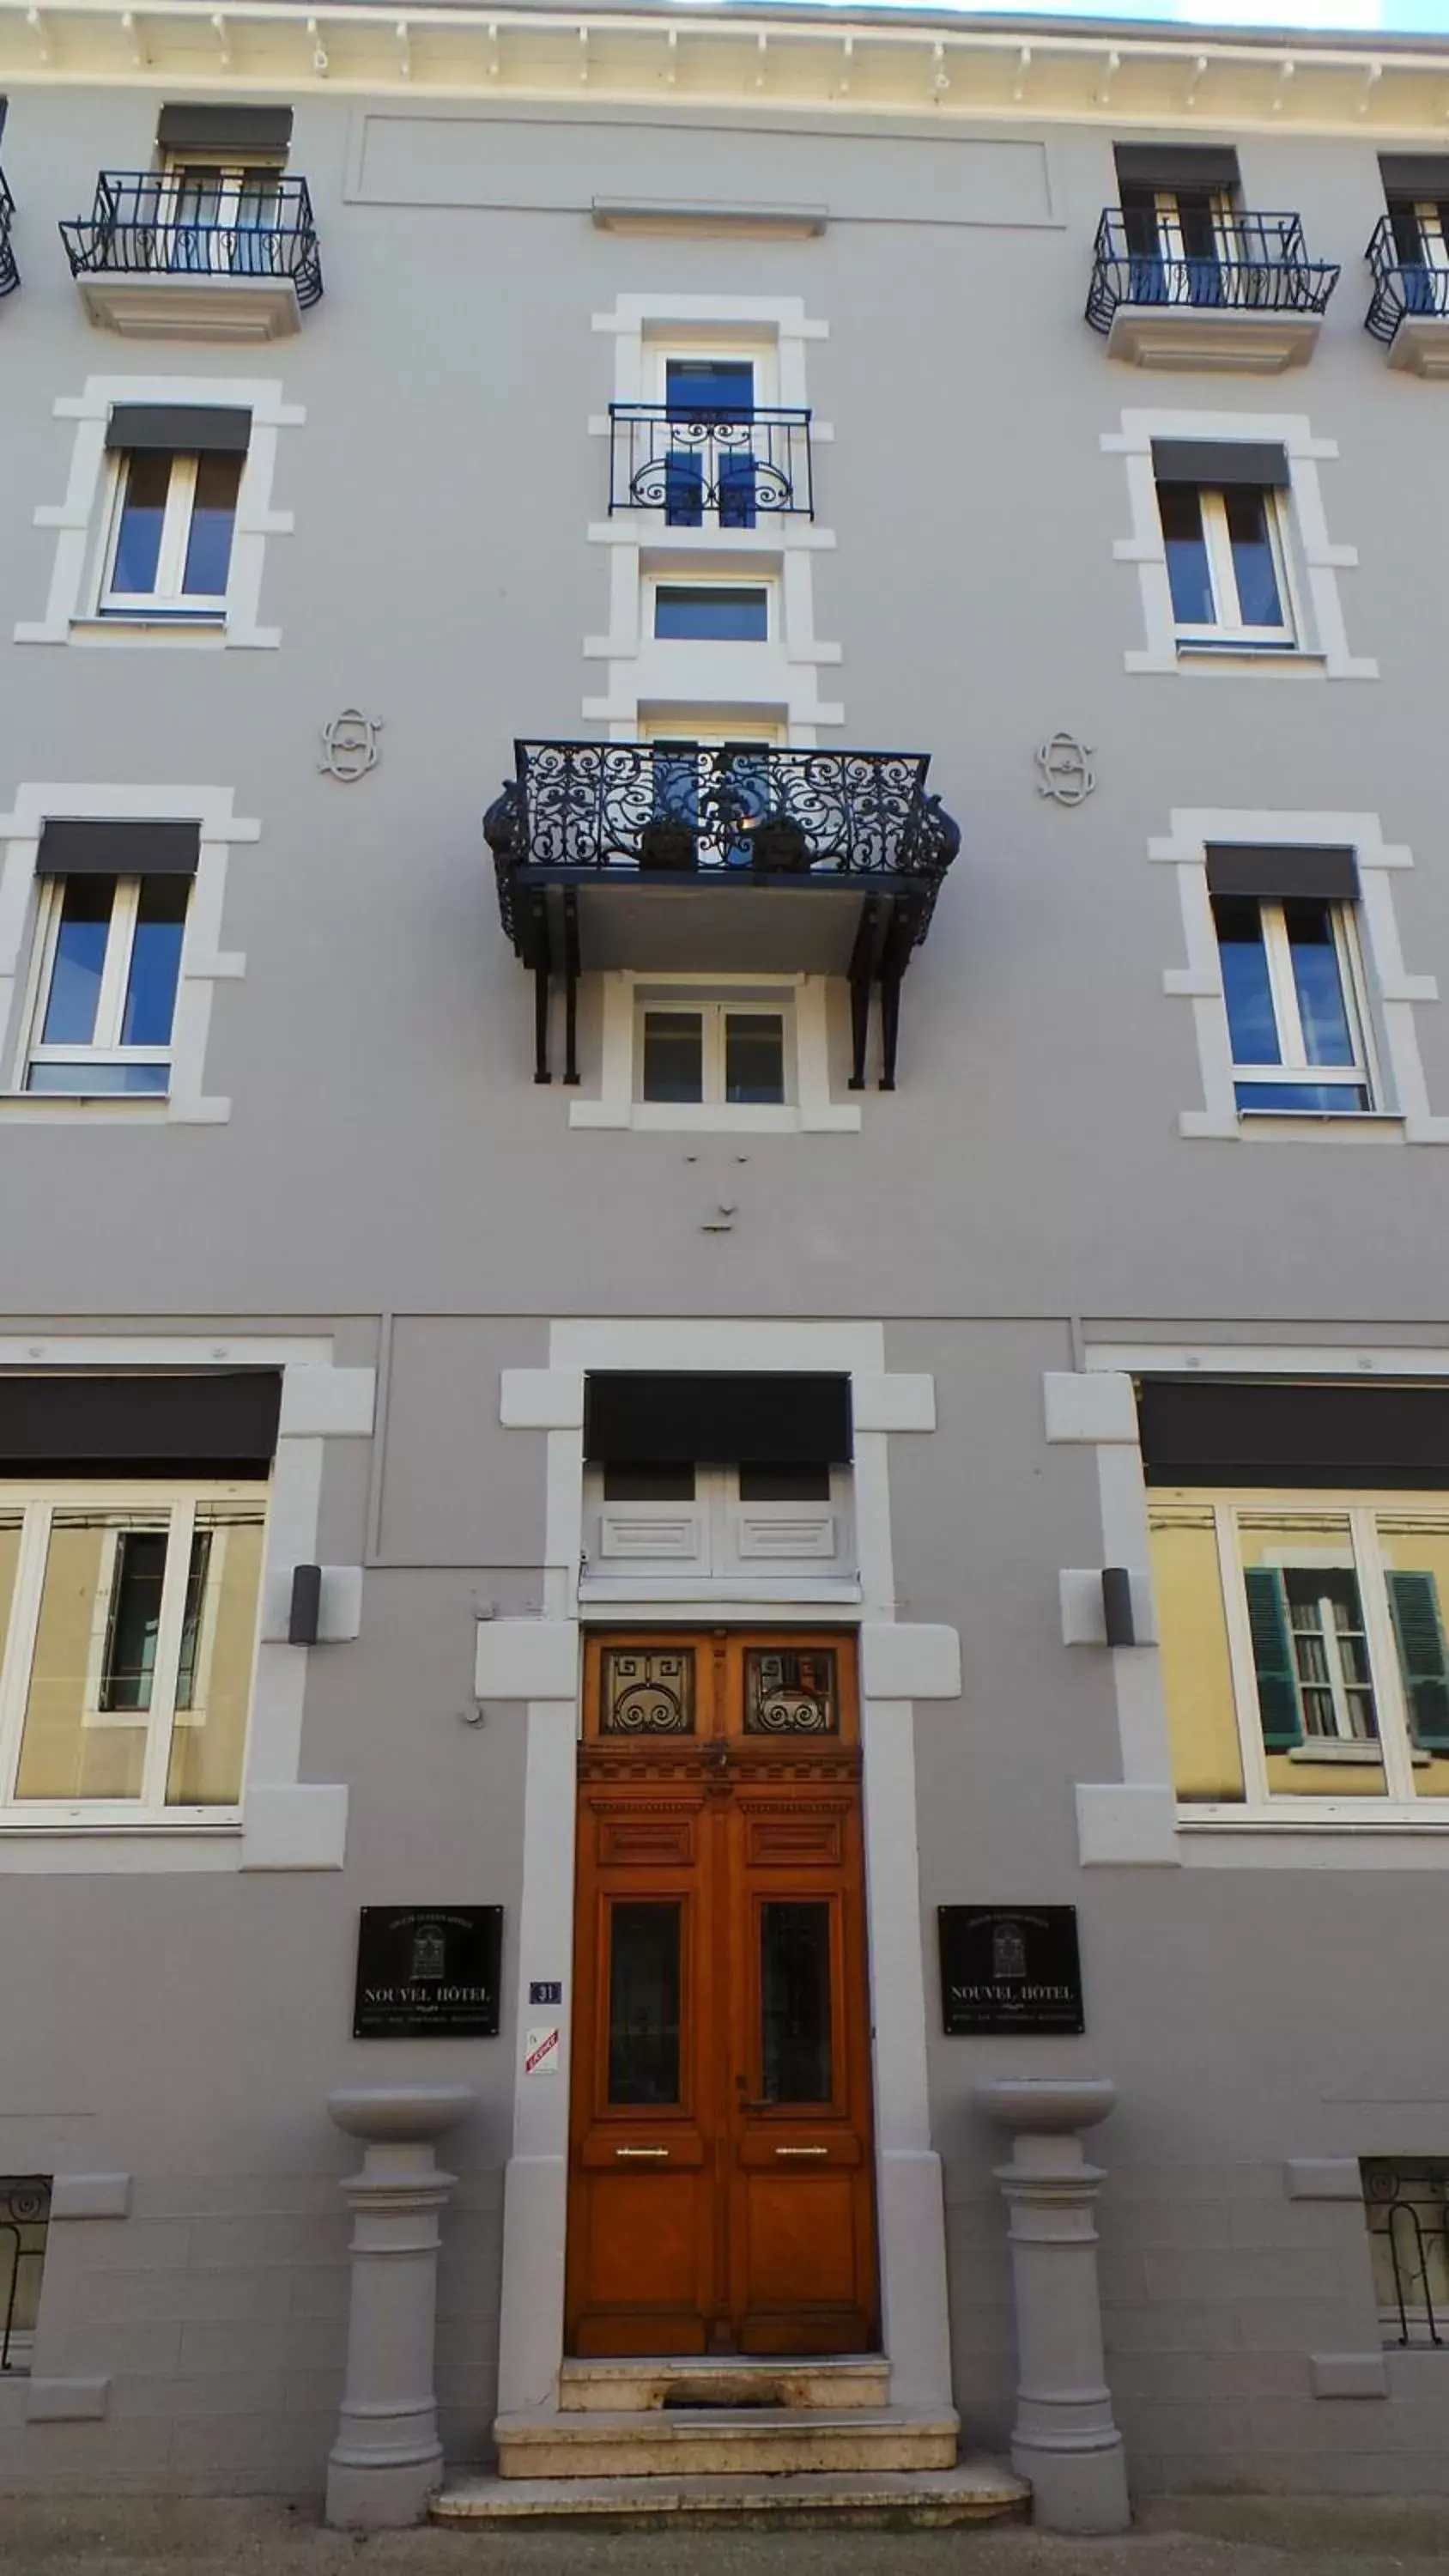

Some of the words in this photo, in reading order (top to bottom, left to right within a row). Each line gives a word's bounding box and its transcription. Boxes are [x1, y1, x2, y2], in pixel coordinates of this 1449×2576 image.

[364, 1987, 432, 2002] NOUVEL
[437, 1985, 491, 2002] HÔTEL
[538, 1986, 553, 2002] 31
[951, 1985, 1016, 2001] NOUVEL
[1022, 1984, 1075, 2000] HÔTEL
